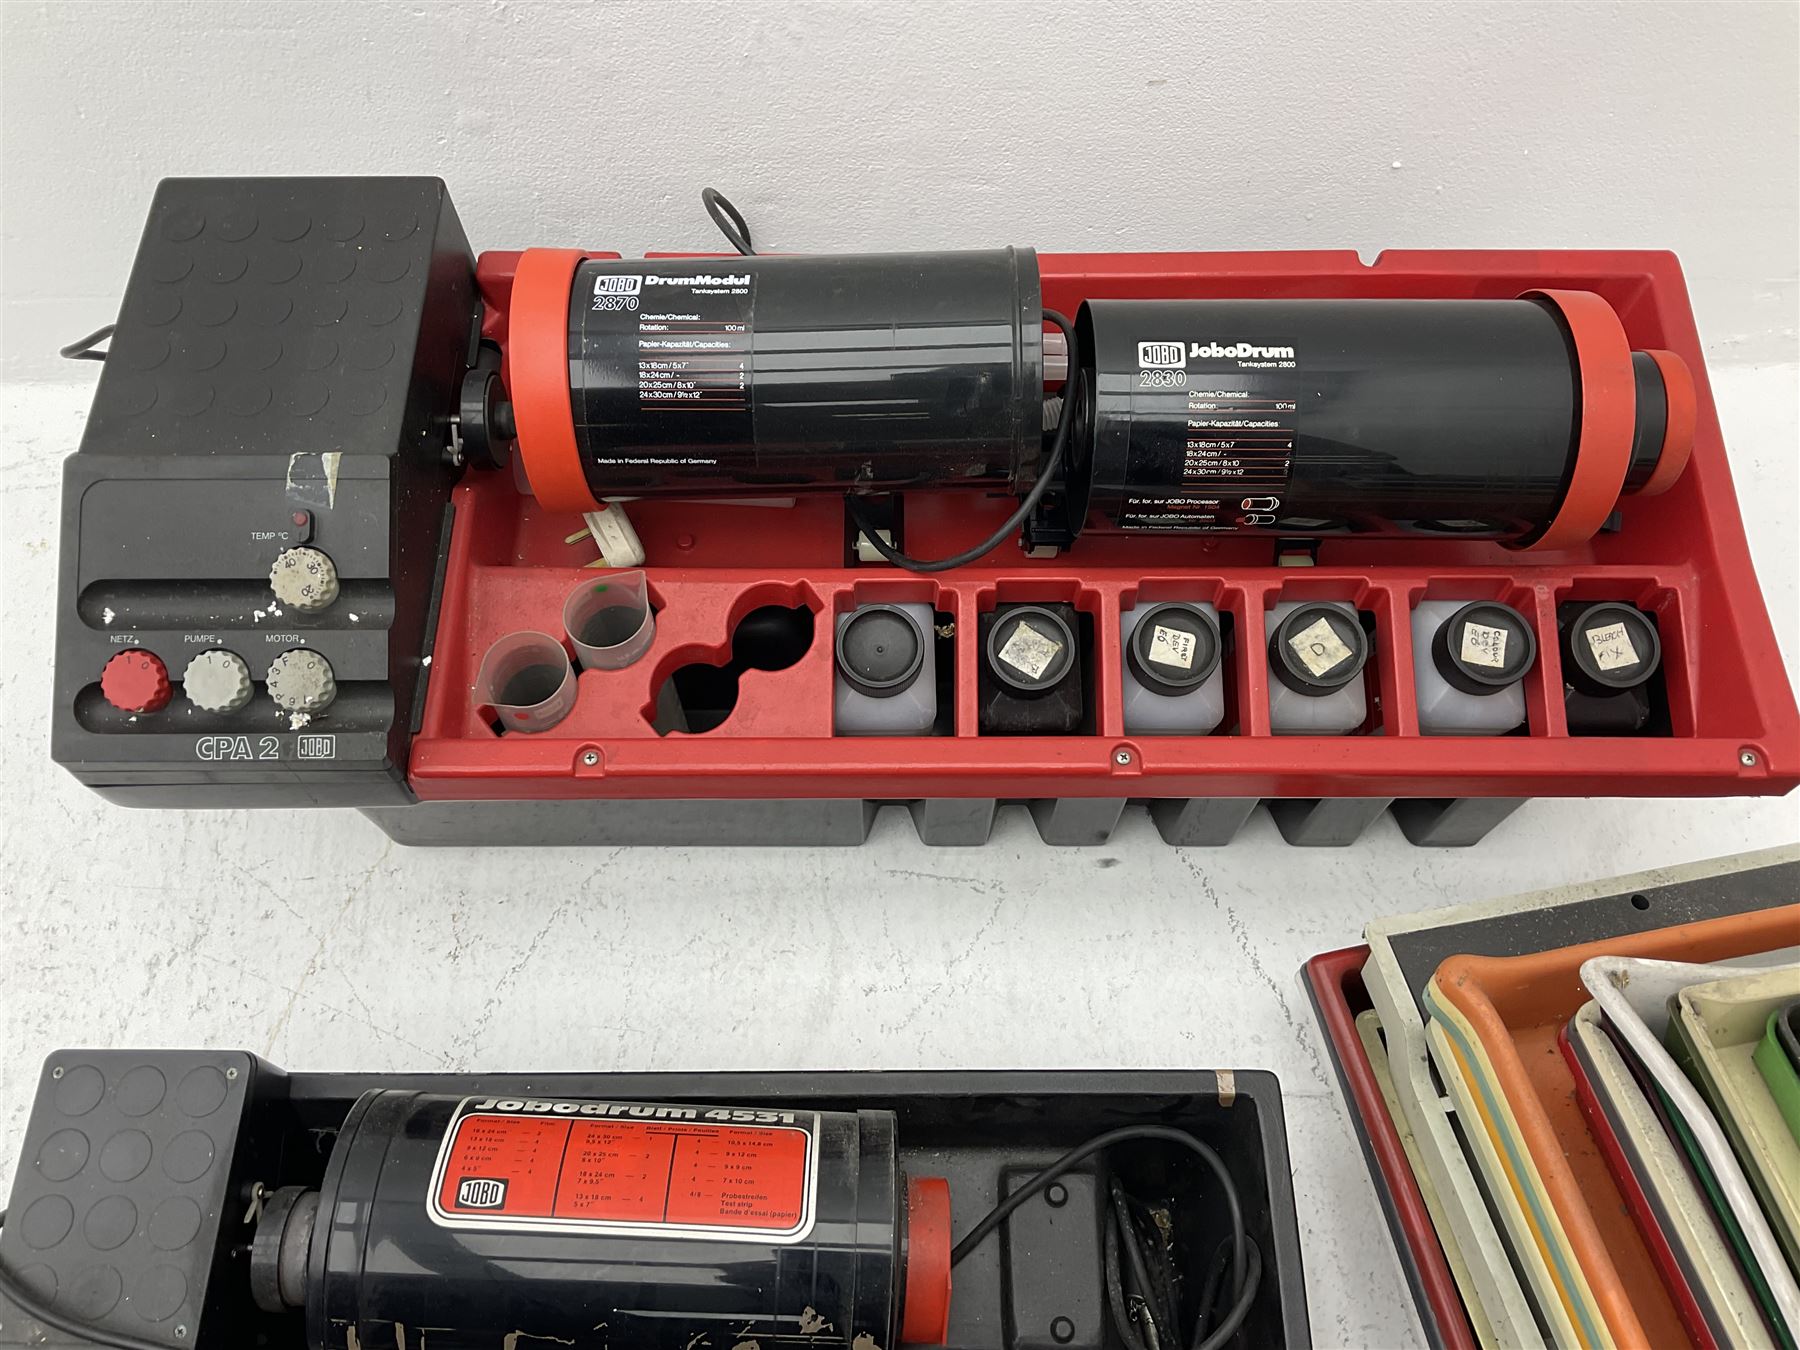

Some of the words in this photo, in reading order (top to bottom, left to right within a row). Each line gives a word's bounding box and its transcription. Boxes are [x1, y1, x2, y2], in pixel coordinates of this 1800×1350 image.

[645, 275, 750, 286] DrumModul
[592, 296, 639, 311] 2870
[1142, 344, 1182, 365] JOBO
[1189, 342, 1295, 359] JoboDrum
[1140, 370, 1187, 387] 2830
[251, 532, 275, 540] TEMP
[285, 558, 296, 568] 40
[307, 562, 318, 574] 30
[302, 584, 314, 596] 20
[110, 635, 134, 643] NETZ
[184, 634, 215, 643] PUMPE
[266, 634, 299, 643] MOTOR
[1592, 627, 1624, 644] BLEACH
[1172, 634, 1180, 654] DEV
[1599, 646, 1623, 660] FIX
[207, 656, 212, 664] 1
[282, 656, 288, 666] F
[196, 736, 253, 760] CPA
[259, 736, 279, 759] 2
[300, 737, 333, 757] JOBO
[475, 1100, 697, 1119] Jobodrum
[704, 1109, 795, 1124] 4531
[460, 1180, 502, 1206] JOBO
[770, 1210, 797, 1218] (papier)
